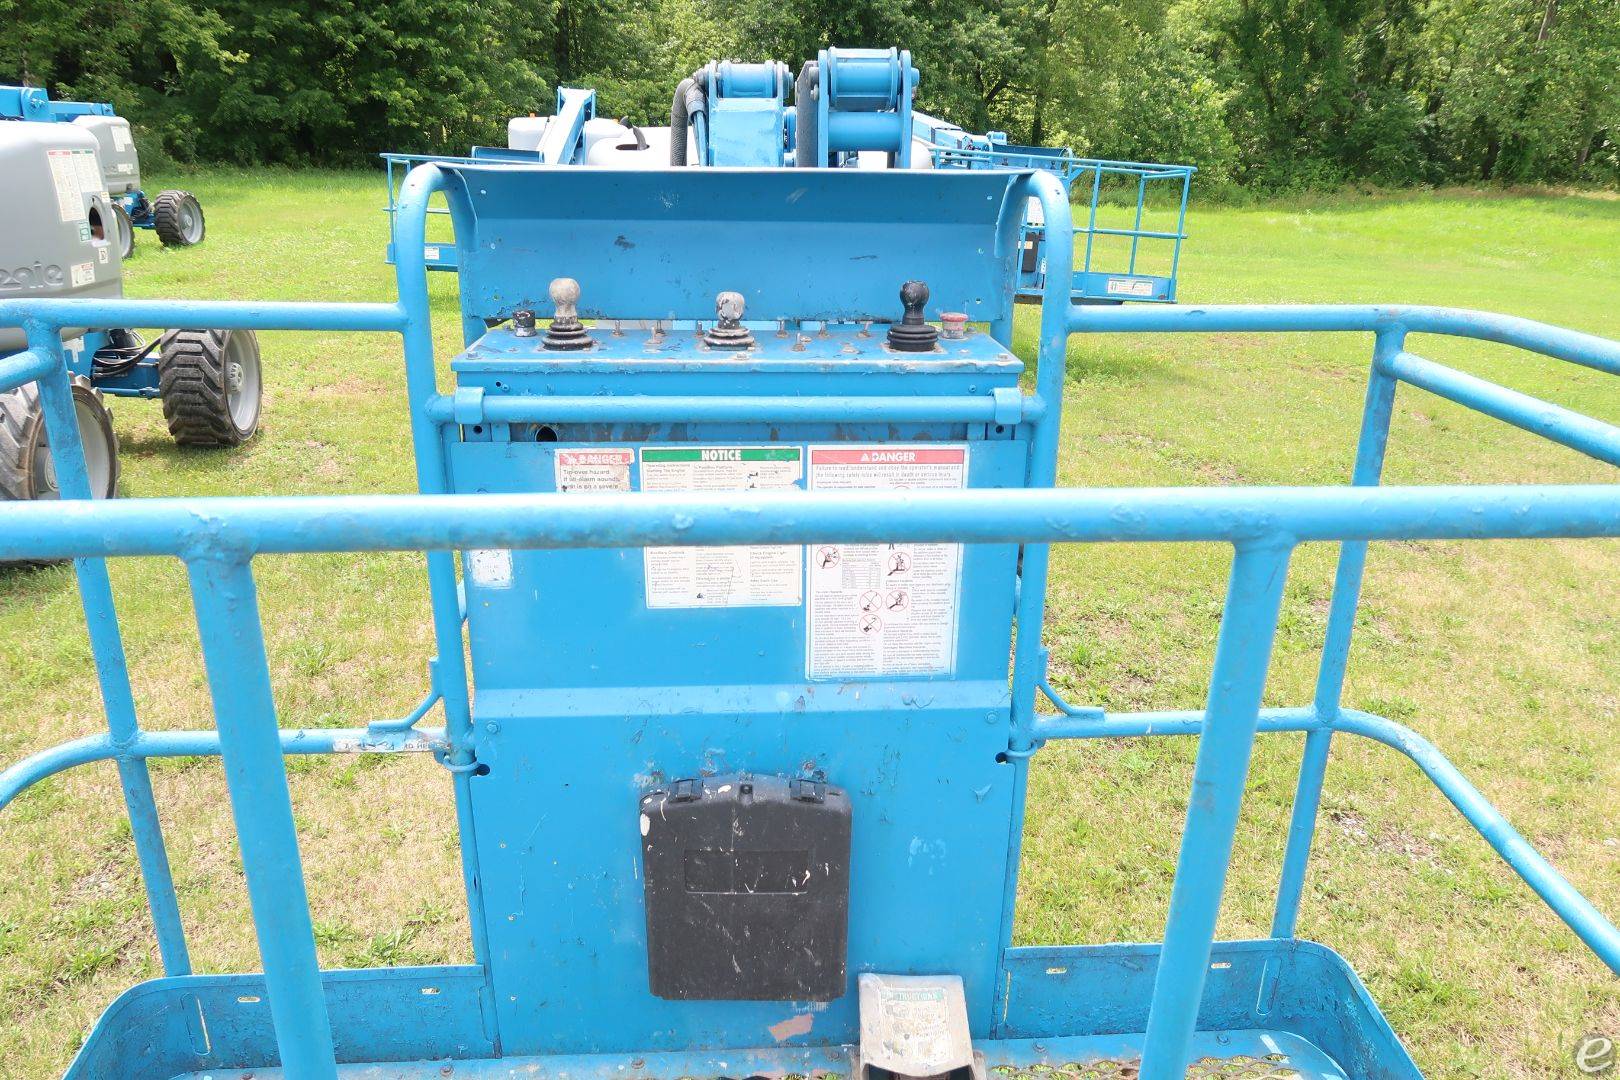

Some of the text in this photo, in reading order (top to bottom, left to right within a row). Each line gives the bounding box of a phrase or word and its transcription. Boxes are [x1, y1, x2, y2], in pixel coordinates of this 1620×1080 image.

[578, 454, 624, 464] DANGER
[701, 450, 742, 461] NOTICE
[871, 452, 916, 462] DANGER
